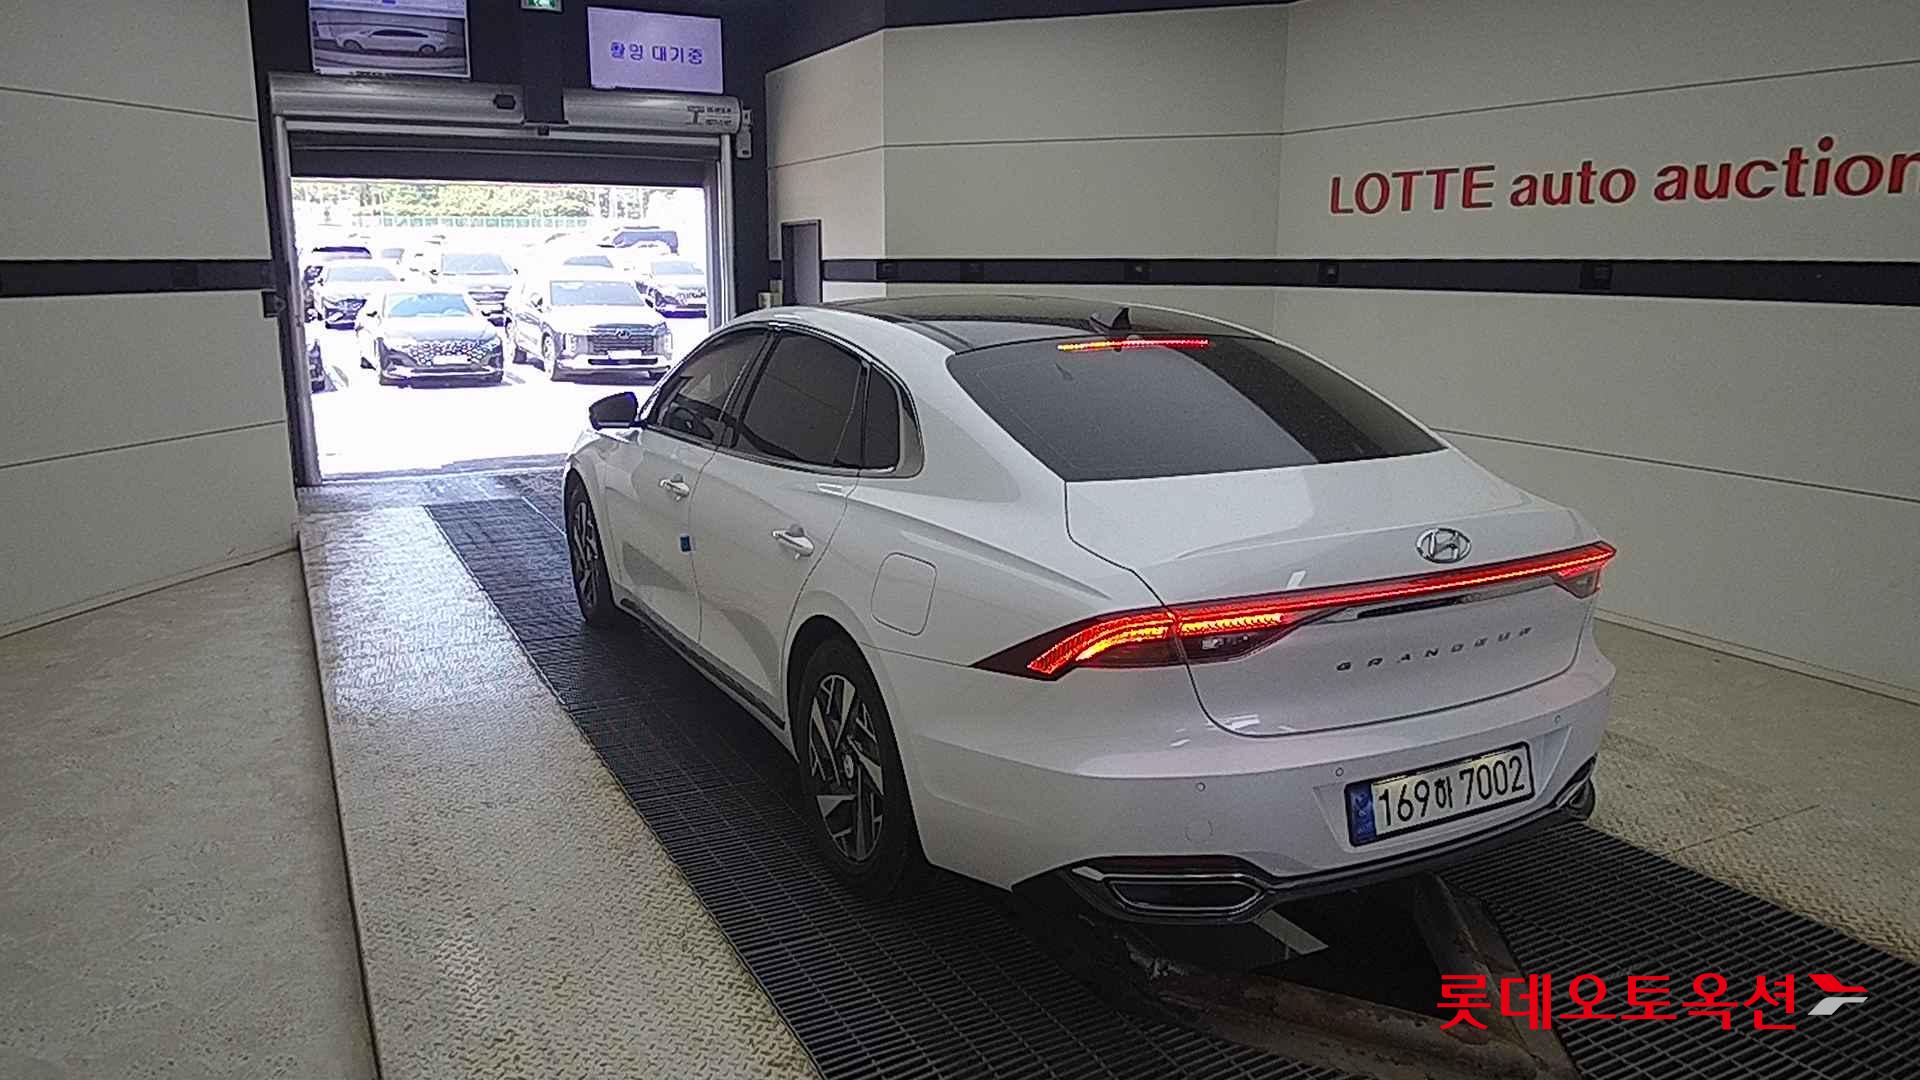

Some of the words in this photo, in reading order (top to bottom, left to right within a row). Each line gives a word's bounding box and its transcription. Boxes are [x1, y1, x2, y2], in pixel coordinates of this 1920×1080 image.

[652, 45, 703, 65] 대기중
[1330, 165, 1495, 214] LOTTE
[1510, 160, 1637, 207] auto
[1654, 136, 1920, 201] auction
[1336, 627, 1532, 671] GRANDEUR
